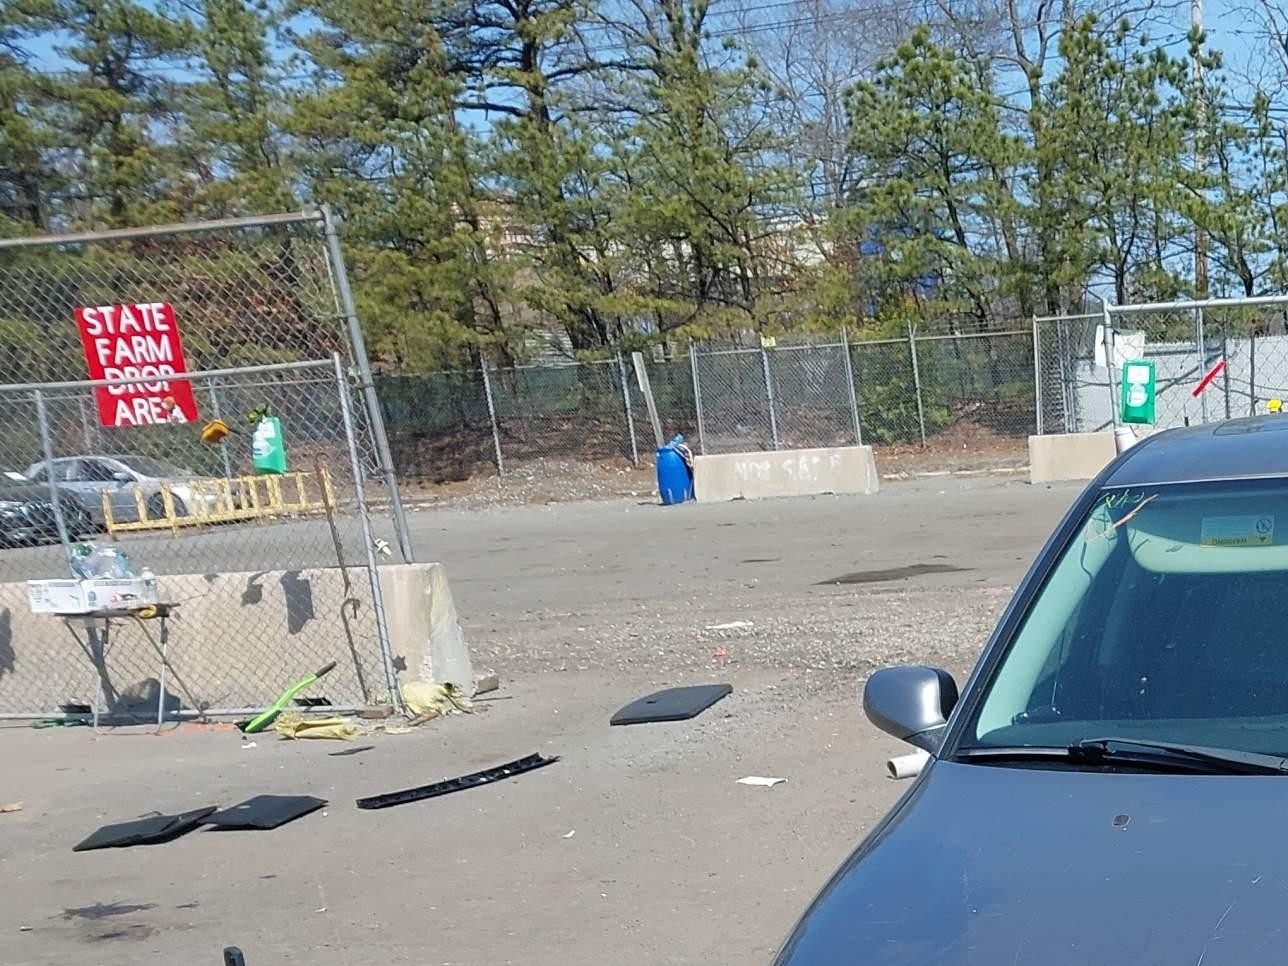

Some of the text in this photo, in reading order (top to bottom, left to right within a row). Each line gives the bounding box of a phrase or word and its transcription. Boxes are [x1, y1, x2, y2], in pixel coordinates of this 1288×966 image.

[83, 303, 169, 335] STATE
[95, 334, 173, 365] FARM
[104, 364, 175, 394] DROP
[115, 397, 187, 425] AREA
